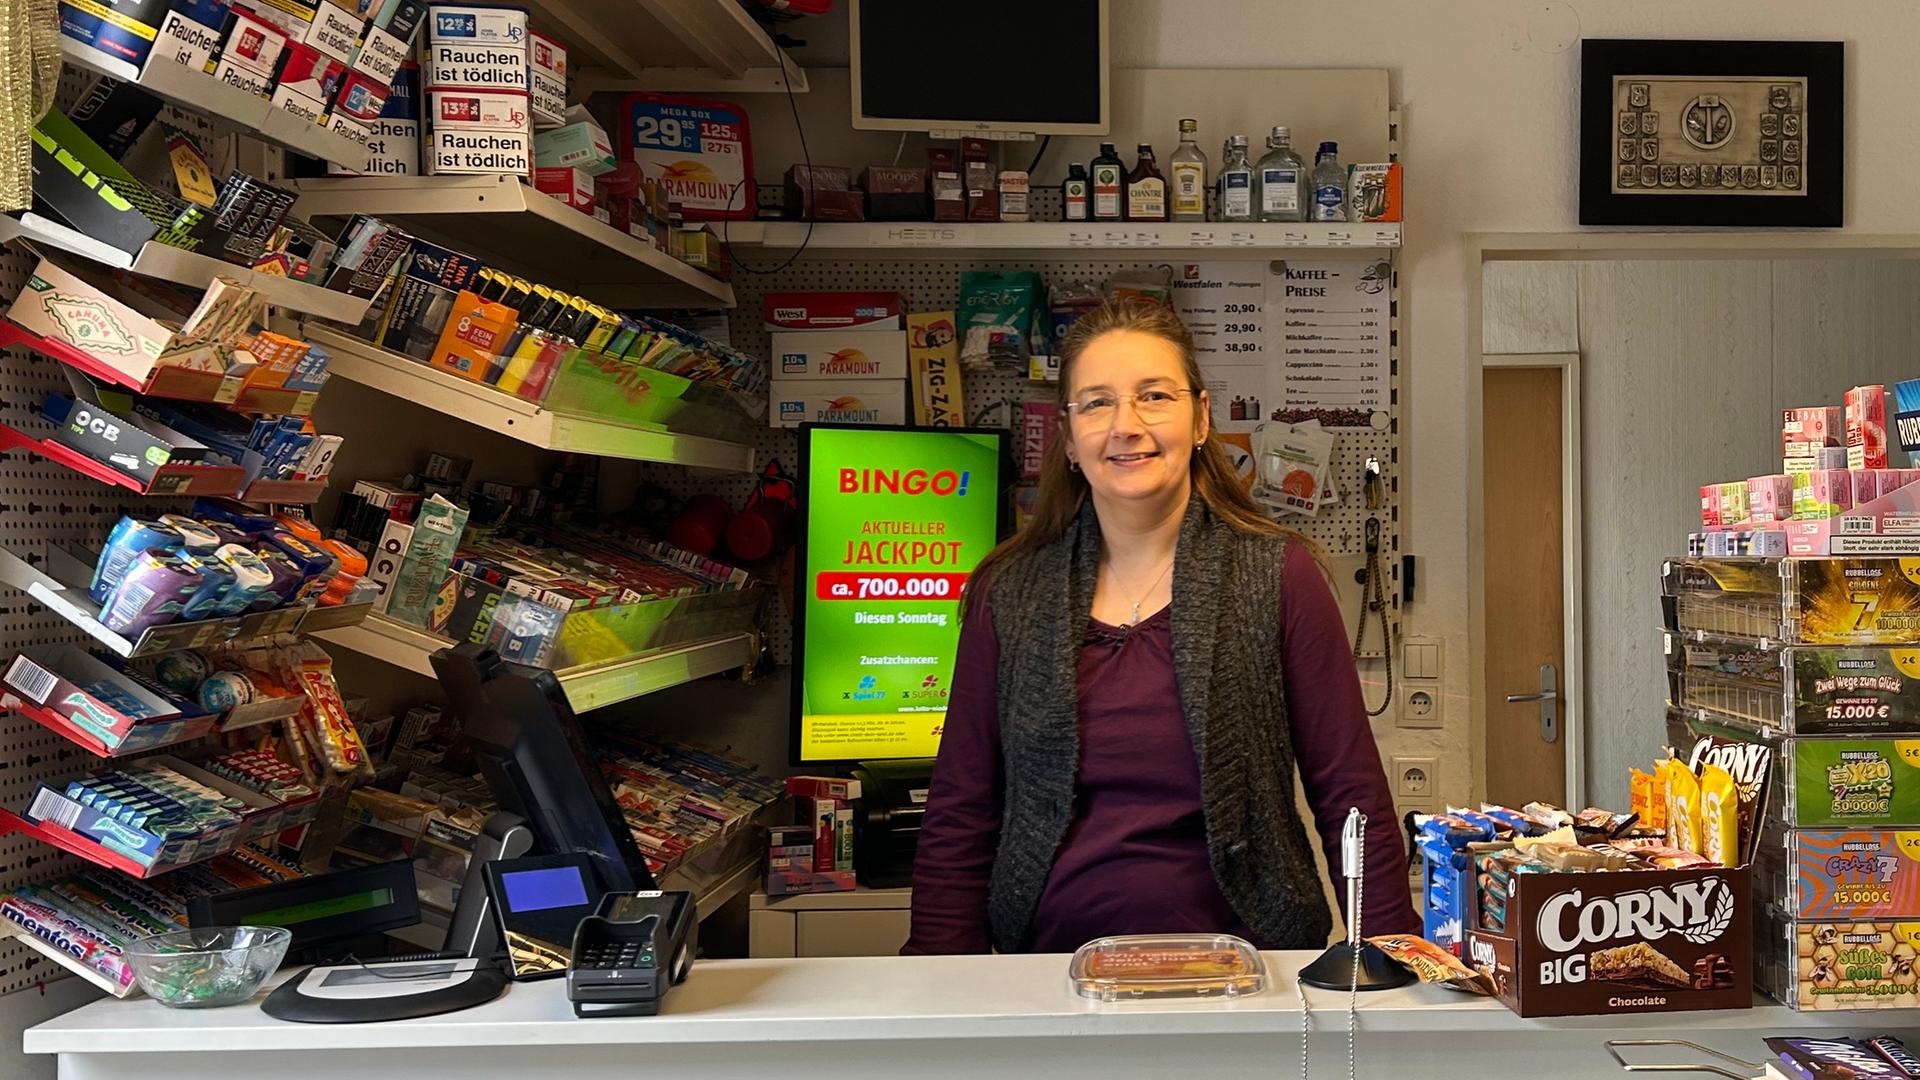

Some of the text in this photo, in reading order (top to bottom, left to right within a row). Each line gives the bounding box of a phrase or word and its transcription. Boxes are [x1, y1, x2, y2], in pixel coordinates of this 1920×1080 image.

[316, 28, 328, 42] ist
[175, 46, 192, 66] ist
[359, 50, 373, 65] ist
[440, 49, 520, 66] Rauchen
[436, 67, 524, 84] ist tödlich
[660, 107, 712, 120] MEGA BOX
[371, 121, 416, 138] chen
[368, 140, 386, 154] st
[442, 134, 522, 151] Rauchen
[438, 152, 527, 169] ist tödlich
[888, 228, 956, 240] HEETS
[1173, 280, 1223, 289] Westfalen
[1285, 285, 1327, 297] PREISE
[776, 309, 804, 319] West
[1224, 304, 1256, 315] 20,90
[457, 316, 494, 341] 8 FEIN
[1224, 323, 1256, 334] 29,90
[1225, 343, 1256, 354] 38,90
[819, 361, 881, 375] PARAMOUNT
[817, 409, 880, 422] PARAMOUNT
[1784, 410, 1823, 422] ELFBAR
[75, 410, 121, 443] OCB
[839, 467, 970, 497] BINGO!
[861, 520, 945, 536] AKTUELLER
[1883, 519, 1901, 527] ELFA
[842, 540, 964, 566] JACKPOT
[1908, 567, 1914, 576] 5
[831, 577, 950, 599] ca. 700.000
[1848, 580, 1880, 591] GOLDENE
[854, 611, 948, 627] Diesen Sonntag
[860, 655, 939, 666] Zusatzchancen:
[1815, 675, 1902, 693] Zwei Wege zum Glück
[1825, 705, 1890, 719] 15.000 €
[1906, 749, 1912, 757] 5
[1907, 839, 1913, 847] 2
[1826, 855, 1880, 878] CRAZY
[1833, 890, 1892, 904] 15.000 €
[1537, 876, 1720, 953] CORNY
[1, 902, 88, 960] mentos
[1839, 948, 1888, 965] Süßes
[1540, 953, 1586, 986] BIG
[1845, 964, 1883, 981] Gold
[1608, 995, 1667, 1008] Chocolate
